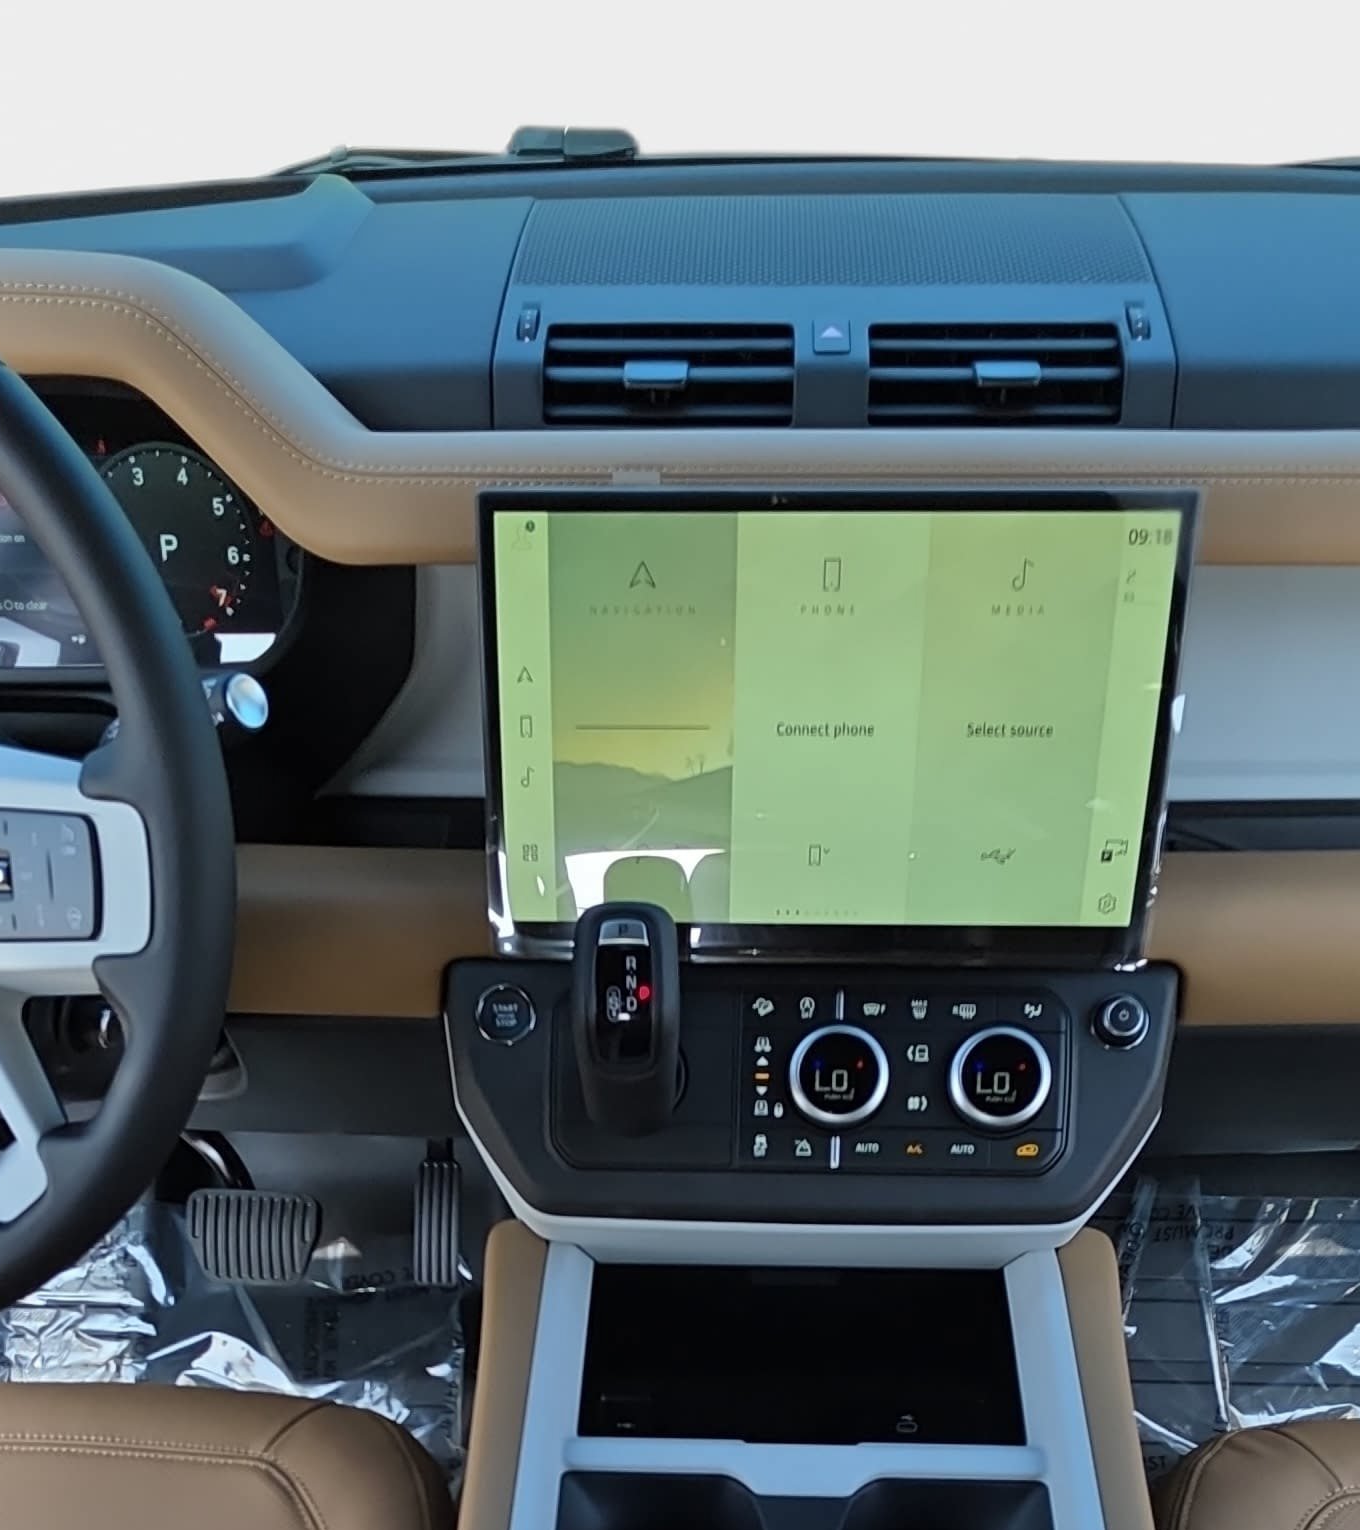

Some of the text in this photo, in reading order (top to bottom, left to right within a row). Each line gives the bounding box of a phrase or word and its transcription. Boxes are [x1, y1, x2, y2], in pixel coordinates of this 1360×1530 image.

[131, 467, 145, 486] 3
[176, 467, 189, 486] 4
[212, 497, 225, 516] 5
[159, 533, 179, 563] P
[227, 546, 240, 565] 6
[215, 588, 228, 607] 7
[800, 604, 856, 616] PHONE
[991, 604, 1045, 616] MEDIA
[776, 722, 875, 741] Connect phone
[966, 722, 1055, 739] Select source
[625, 955, 638, 972] R
[625, 975, 638, 989] N
[625, 996, 638, 1012] D
[814, 1069, 849, 1093] LO
[976, 1071, 1011, 1095] LO
[855, 1142, 880, 1153] AUTO
[950, 1143, 976, 1155] AUTO
